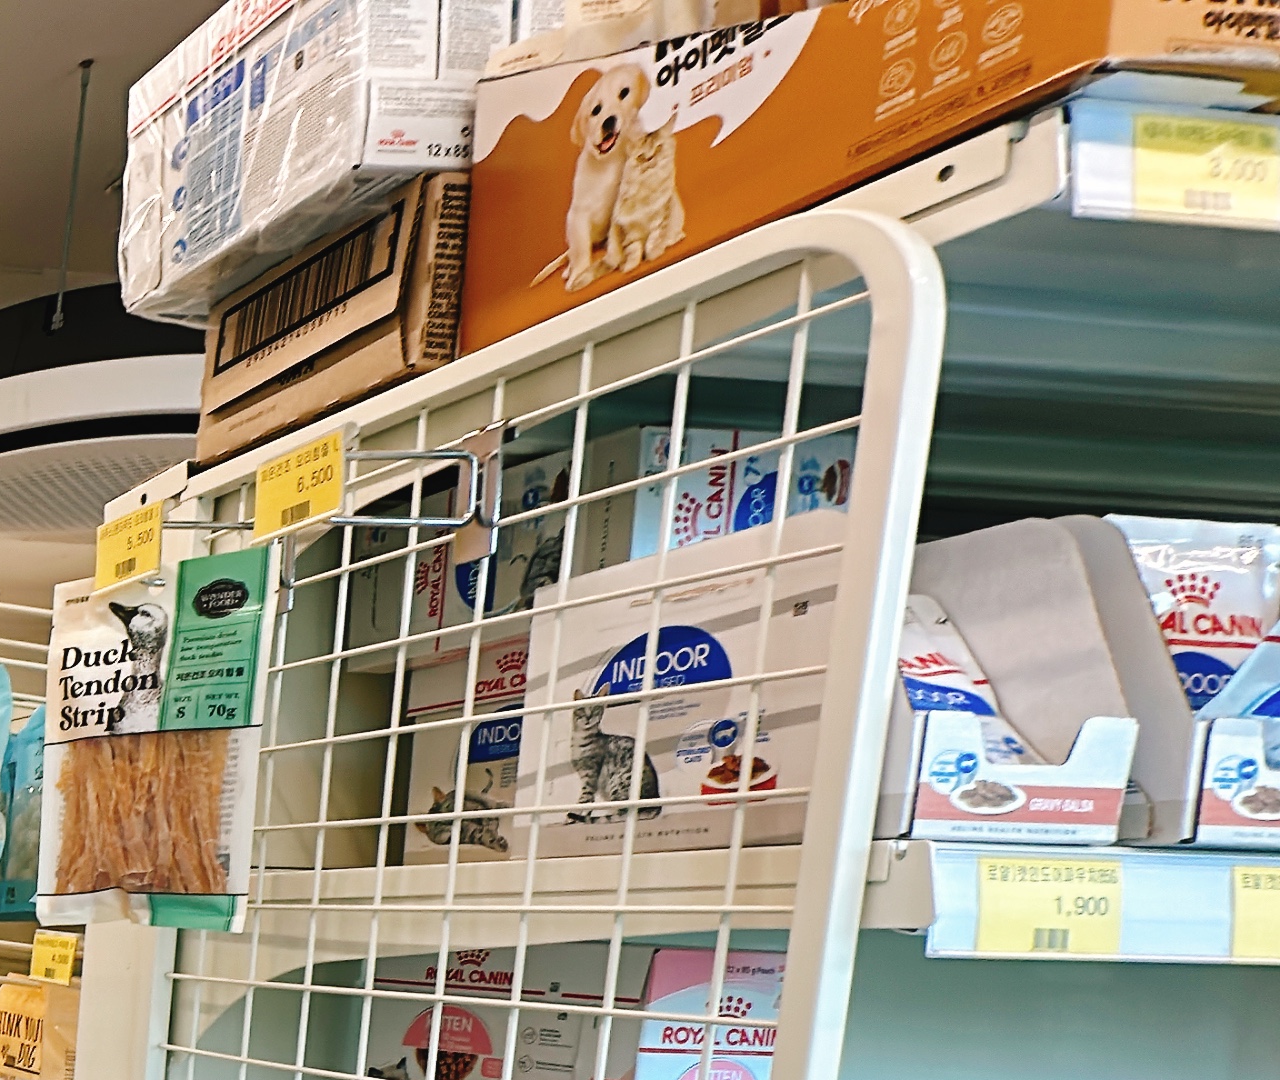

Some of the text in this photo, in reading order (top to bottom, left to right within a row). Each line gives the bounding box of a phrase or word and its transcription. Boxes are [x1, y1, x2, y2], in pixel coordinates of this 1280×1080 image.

[689, 53, 754, 106] 프리미엄
[426, 143, 442, 157] 12
[296, 466, 335, 494] 6,500
[710, 447, 730, 519] CANIN
[426, 574, 441, 617] ROYAL
[1192, 611, 1264, 638] CANIN
[59, 639, 137, 672] Duck
[58, 668, 159, 702] Tendon
[58, 700, 126, 733] Strip
[175, 706, 187, 719] S
[207, 703, 238, 721] 70g
[1053, 895, 1109, 919] 1,900
[17, 1043, 37, 1068] DOG
